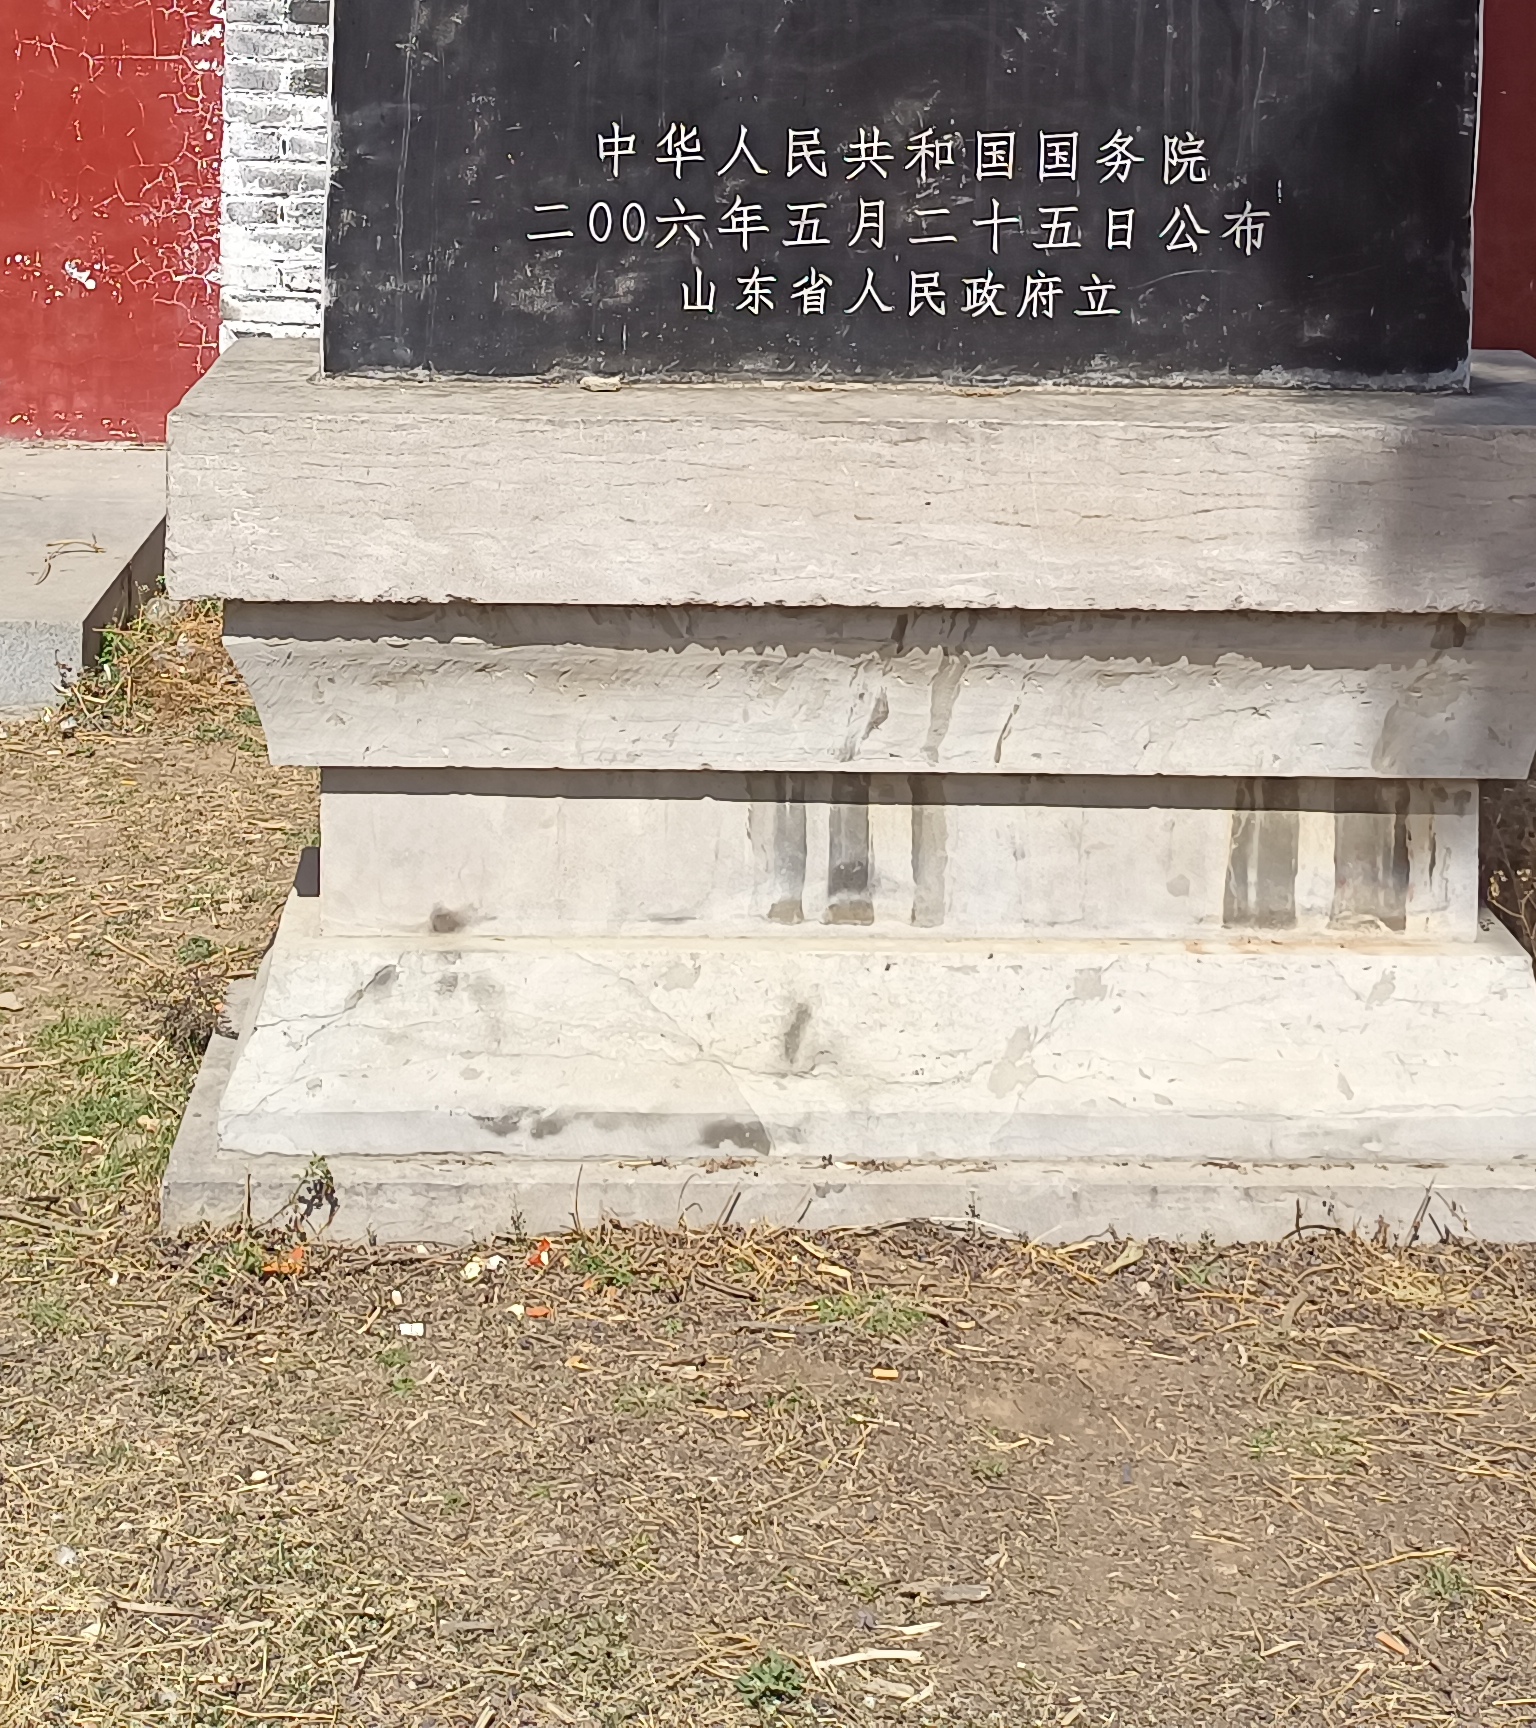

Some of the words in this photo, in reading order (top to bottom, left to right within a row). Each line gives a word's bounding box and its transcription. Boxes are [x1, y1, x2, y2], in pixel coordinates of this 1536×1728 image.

[594, 120, 1211, 186] 中华人民共和国国务院
[679, 265, 1122, 318] 山东省人民政府立
